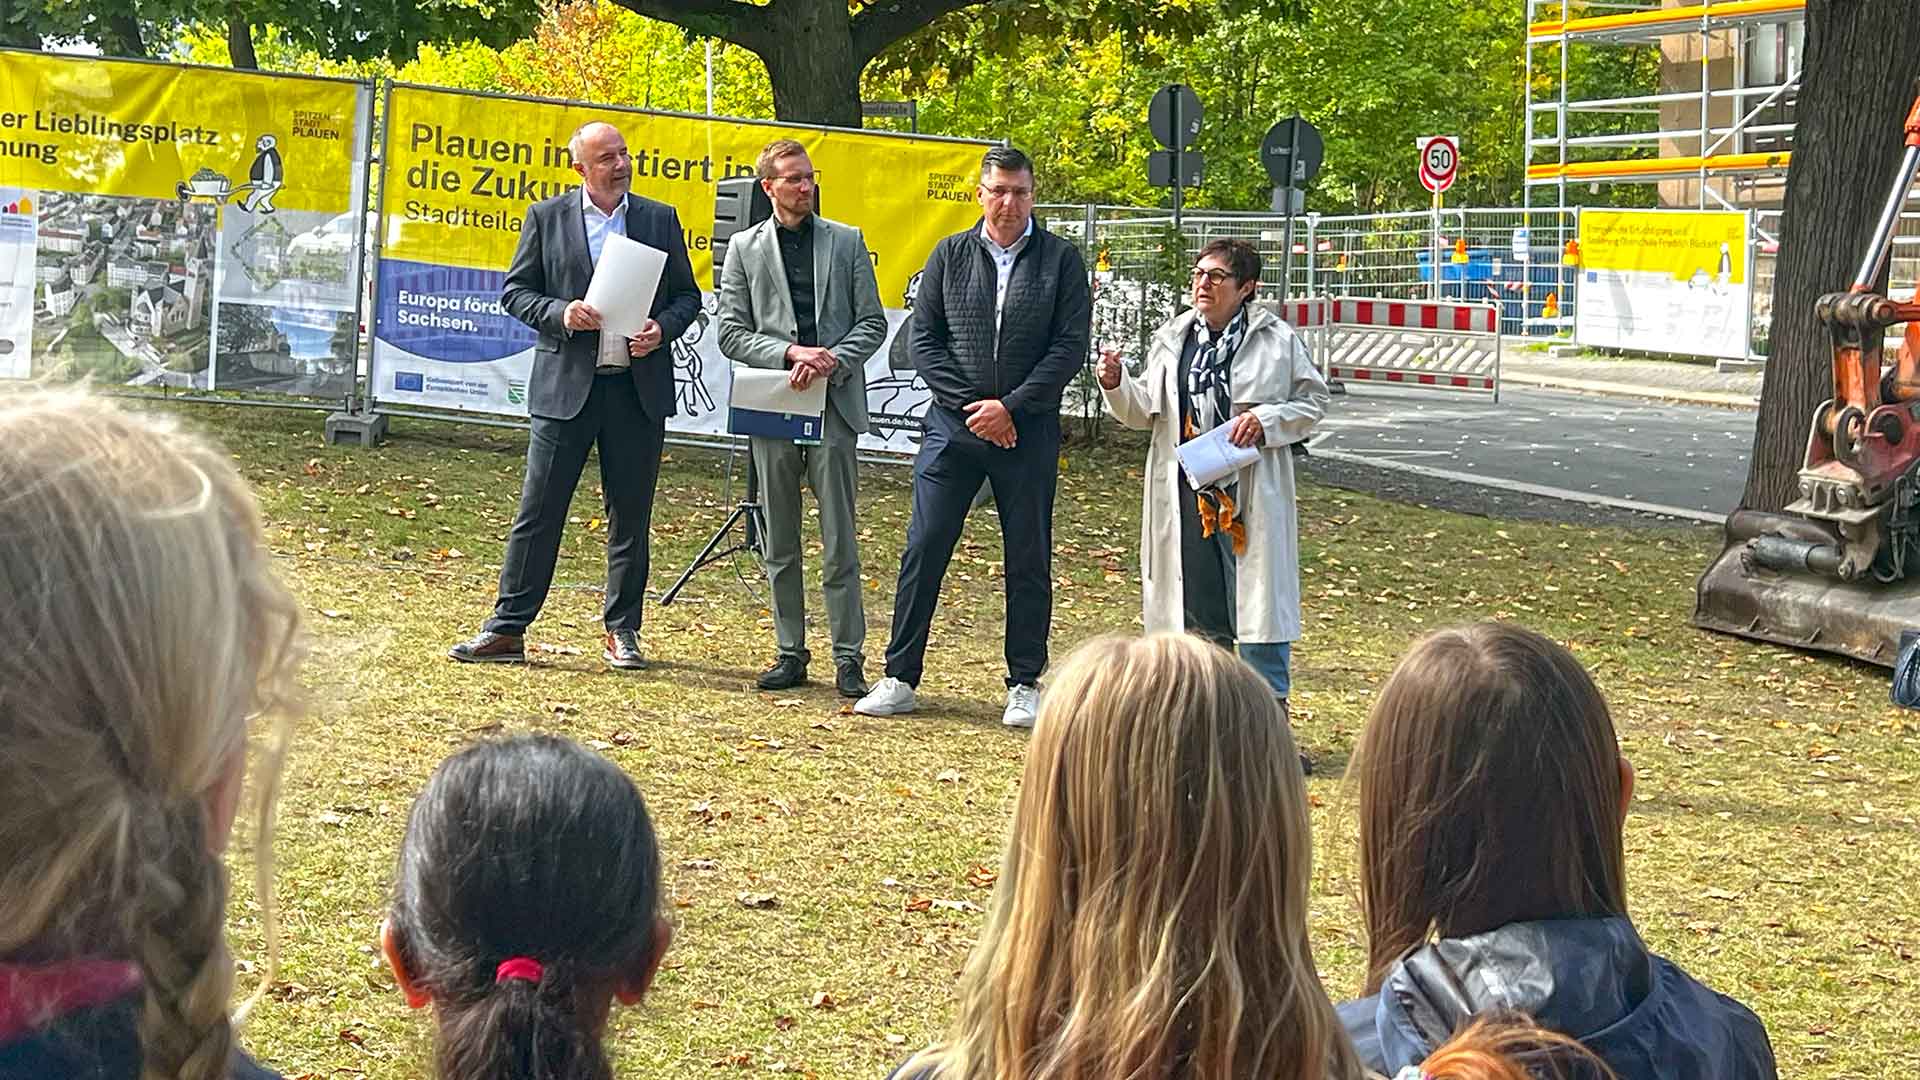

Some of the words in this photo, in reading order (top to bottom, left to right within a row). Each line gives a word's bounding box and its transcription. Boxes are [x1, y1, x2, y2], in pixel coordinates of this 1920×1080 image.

[36, 110, 218, 146] Lieblingsplatz
[292, 127, 339, 140] PLAUEN
[293, 119, 320, 128] STADT
[411, 123, 532, 165] Plauen
[543, 138, 713, 183] intiert
[1431, 149, 1450, 169] 50
[407, 160, 461, 192] die
[928, 181, 955, 190] STADT
[929, 172, 965, 183] SPITZEN
[927, 189, 972, 202] PLAUEN
[404, 200, 522, 232] Stadtteila
[398, 289, 461, 313] Europa
[398, 309, 478, 332] Sachsen.
